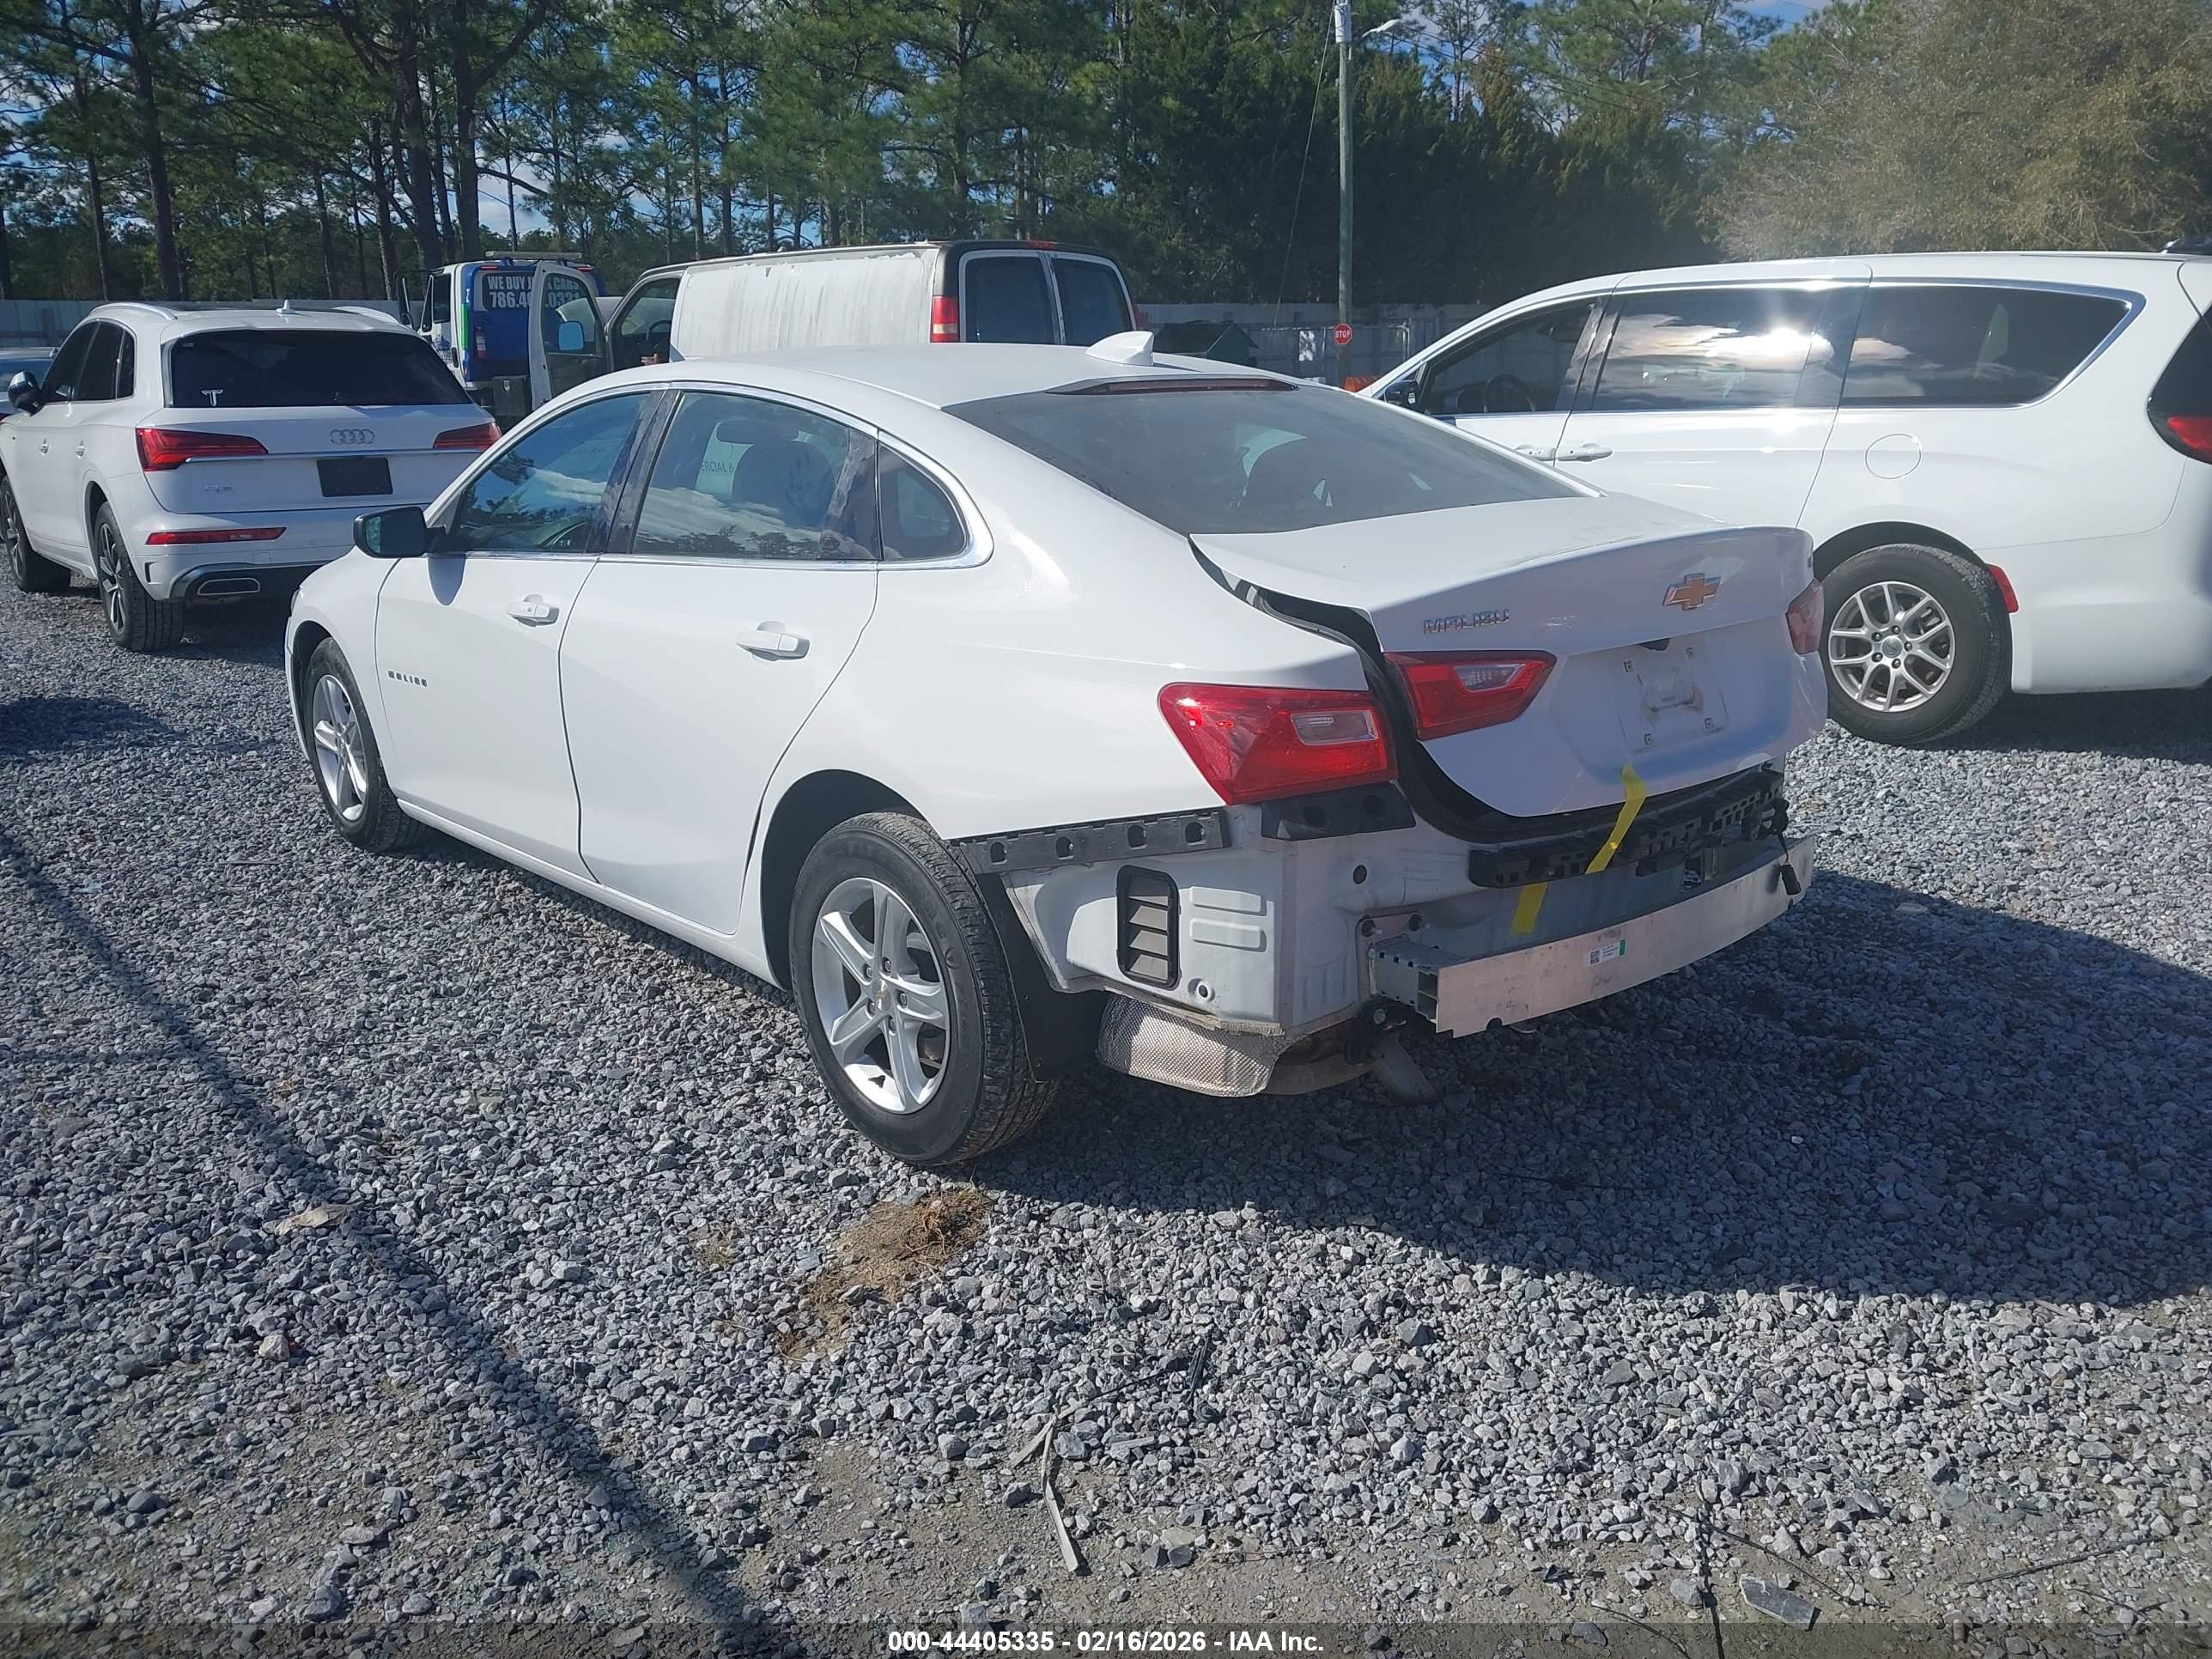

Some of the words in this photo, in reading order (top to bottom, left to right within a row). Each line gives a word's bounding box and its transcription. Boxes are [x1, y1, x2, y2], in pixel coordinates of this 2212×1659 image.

[488, 276, 504, 289] WE
[506, 276, 525, 289] BUY
[553, 276, 579, 290] CARS
[1335, 330, 1351, 338] STOP
